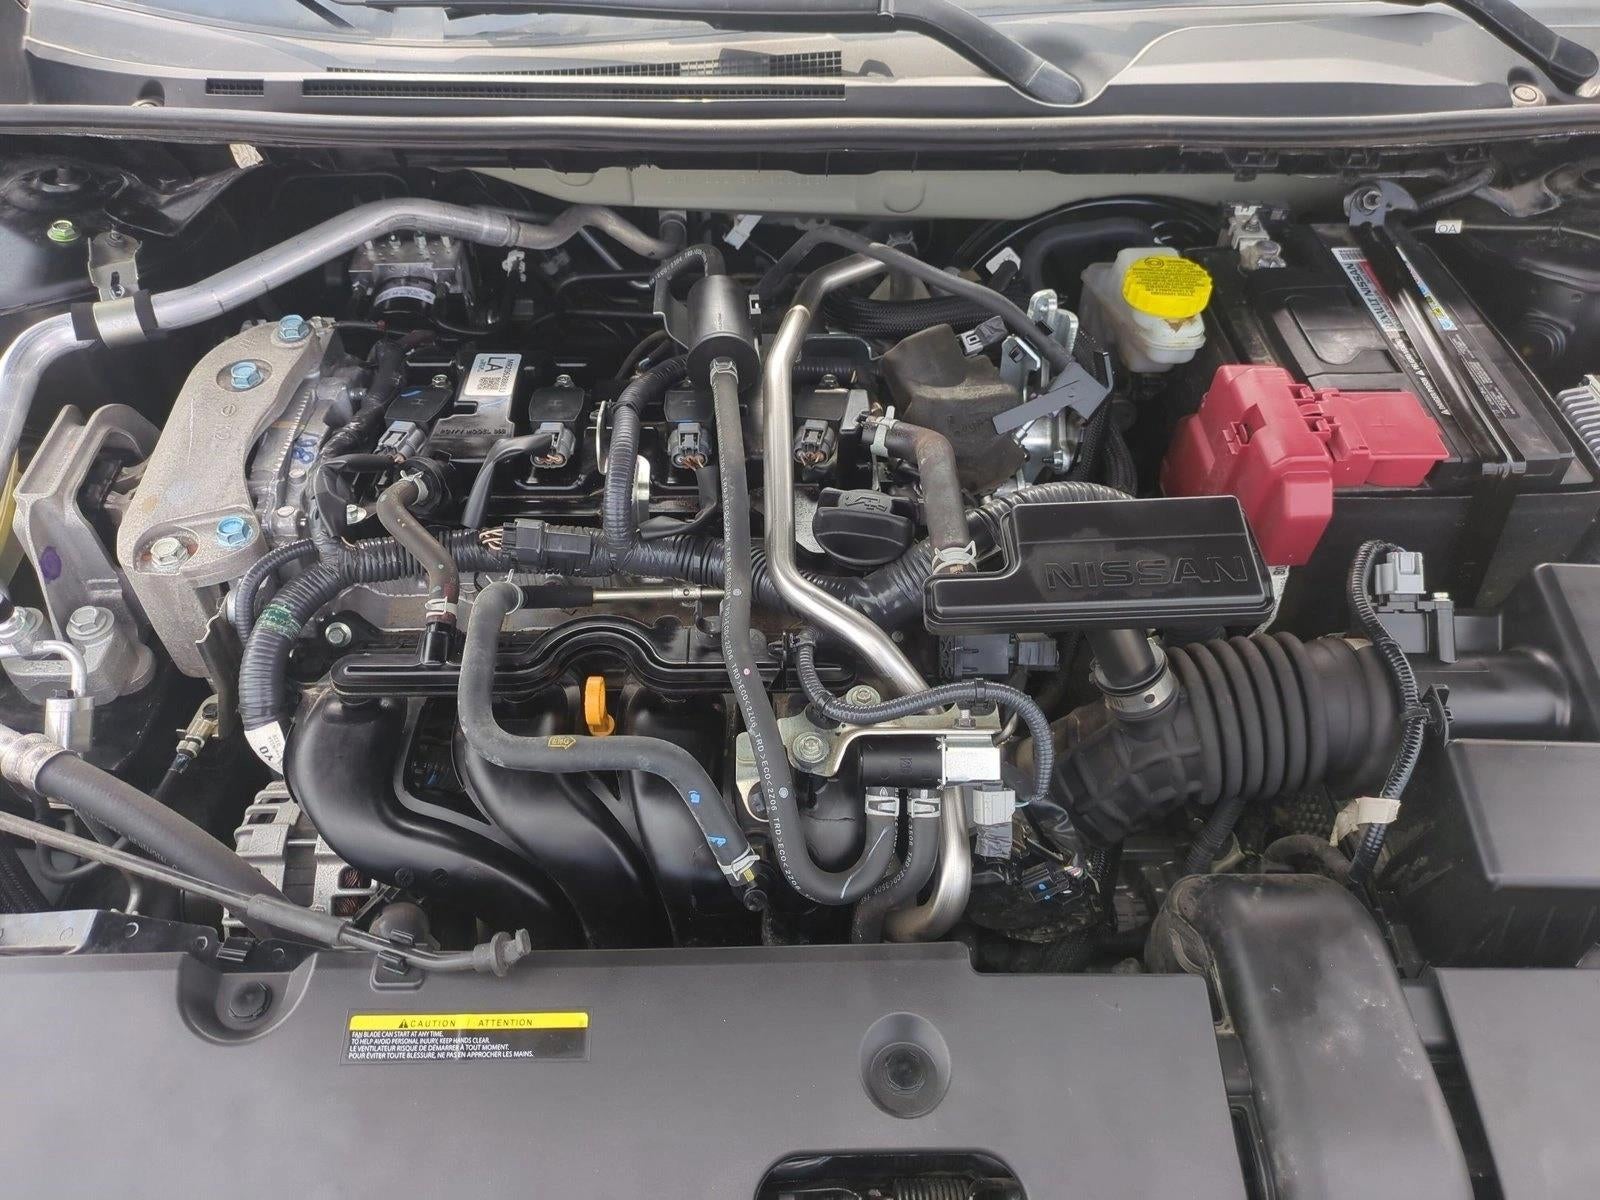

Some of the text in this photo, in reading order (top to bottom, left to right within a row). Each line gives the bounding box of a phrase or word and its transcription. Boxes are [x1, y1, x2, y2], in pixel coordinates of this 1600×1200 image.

[1346, 262, 1374, 297] NISSAN
[484, 356, 506, 372] LA
[1045, 555, 1249, 589] NISSAN
[410, 1019, 456, 1028] CAUTION
[478, 1019, 533, 1027] ATTENTION
